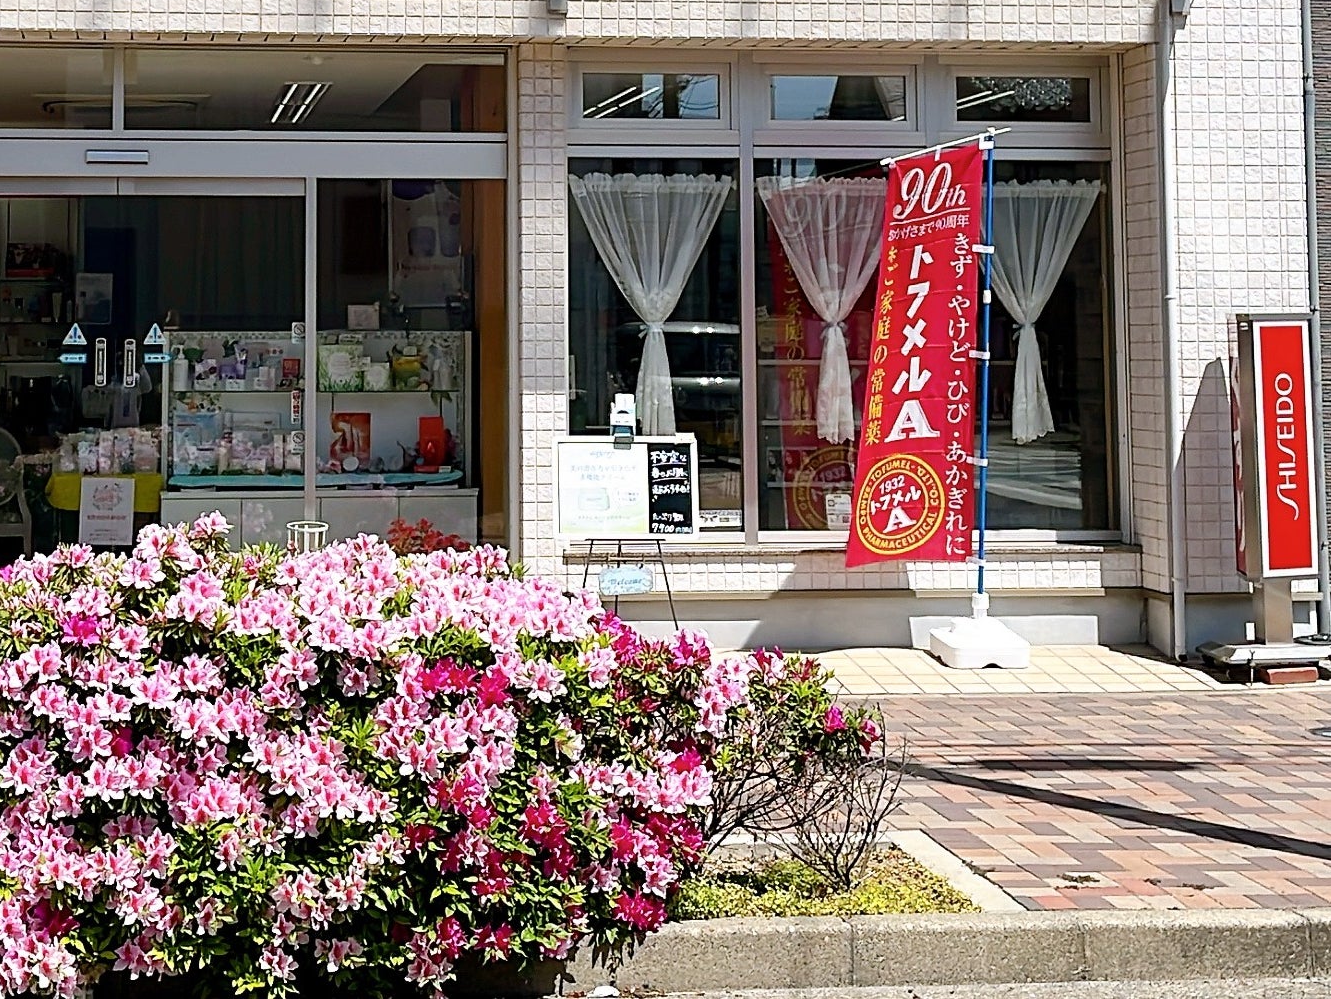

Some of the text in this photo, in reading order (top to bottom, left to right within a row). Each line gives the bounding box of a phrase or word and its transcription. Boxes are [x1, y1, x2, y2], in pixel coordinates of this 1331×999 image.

[893, 162, 967, 219] 90th
[888, 214, 970, 242] おかげさまで90周年
[883, 243, 940, 441] トフメルA
[944, 232, 973, 557] きず・やけど・ひび・あかぎれに
[1274, 372, 1299, 522] SHISEIDO
[870, 485, 922, 515] トフメル
[879, 474, 906, 494] 1932
[862, 512, 938, 549] PHARMACEUTICAL
[882, 506, 918, 534] A
